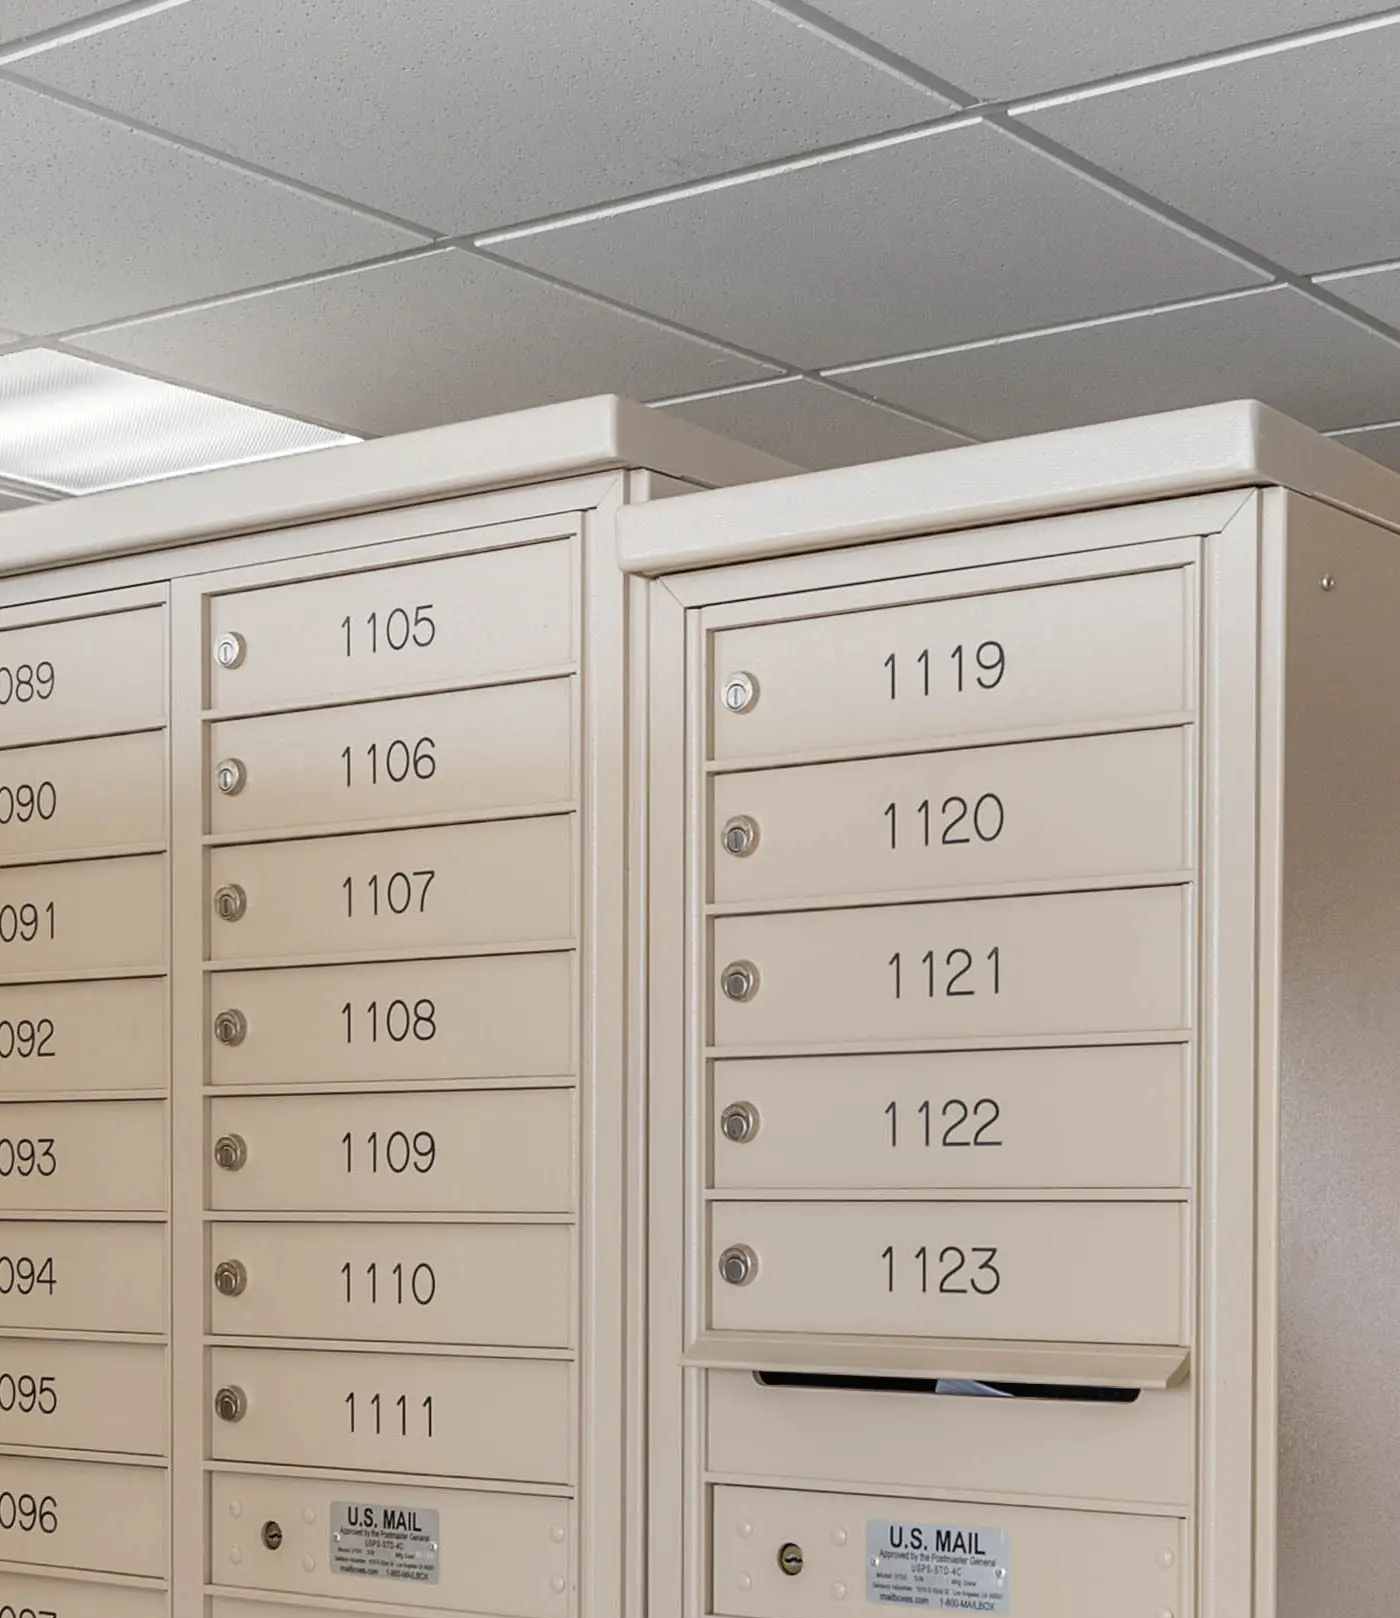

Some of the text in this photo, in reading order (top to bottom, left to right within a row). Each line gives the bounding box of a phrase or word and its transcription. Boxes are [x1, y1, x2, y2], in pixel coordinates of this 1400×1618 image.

[341, 603, 436, 657] 1105
[883, 640, 1006, 701] 1119
[341, 736, 436, 788] 1106
[883, 792, 1005, 850] 1120
[342, 869, 436, 918] 1107
[888, 946, 1000, 1000] 1121
[341, 998, 437, 1044] 1108
[884, 1098, 1003, 1148] 1122
[341, 1130, 436, 1174] 1109
[341, 1261, 436, 1306] 1110
[881, 1245, 1001, 1296] 1123
[344, 1391, 433, 1438] 1111
[348, 1506, 422, 1532] U.S. MAIL
[889, 1525, 986, 1555] U.S. MAIL
[880, 1549, 996, 1568] Approved by the Postmaster General
